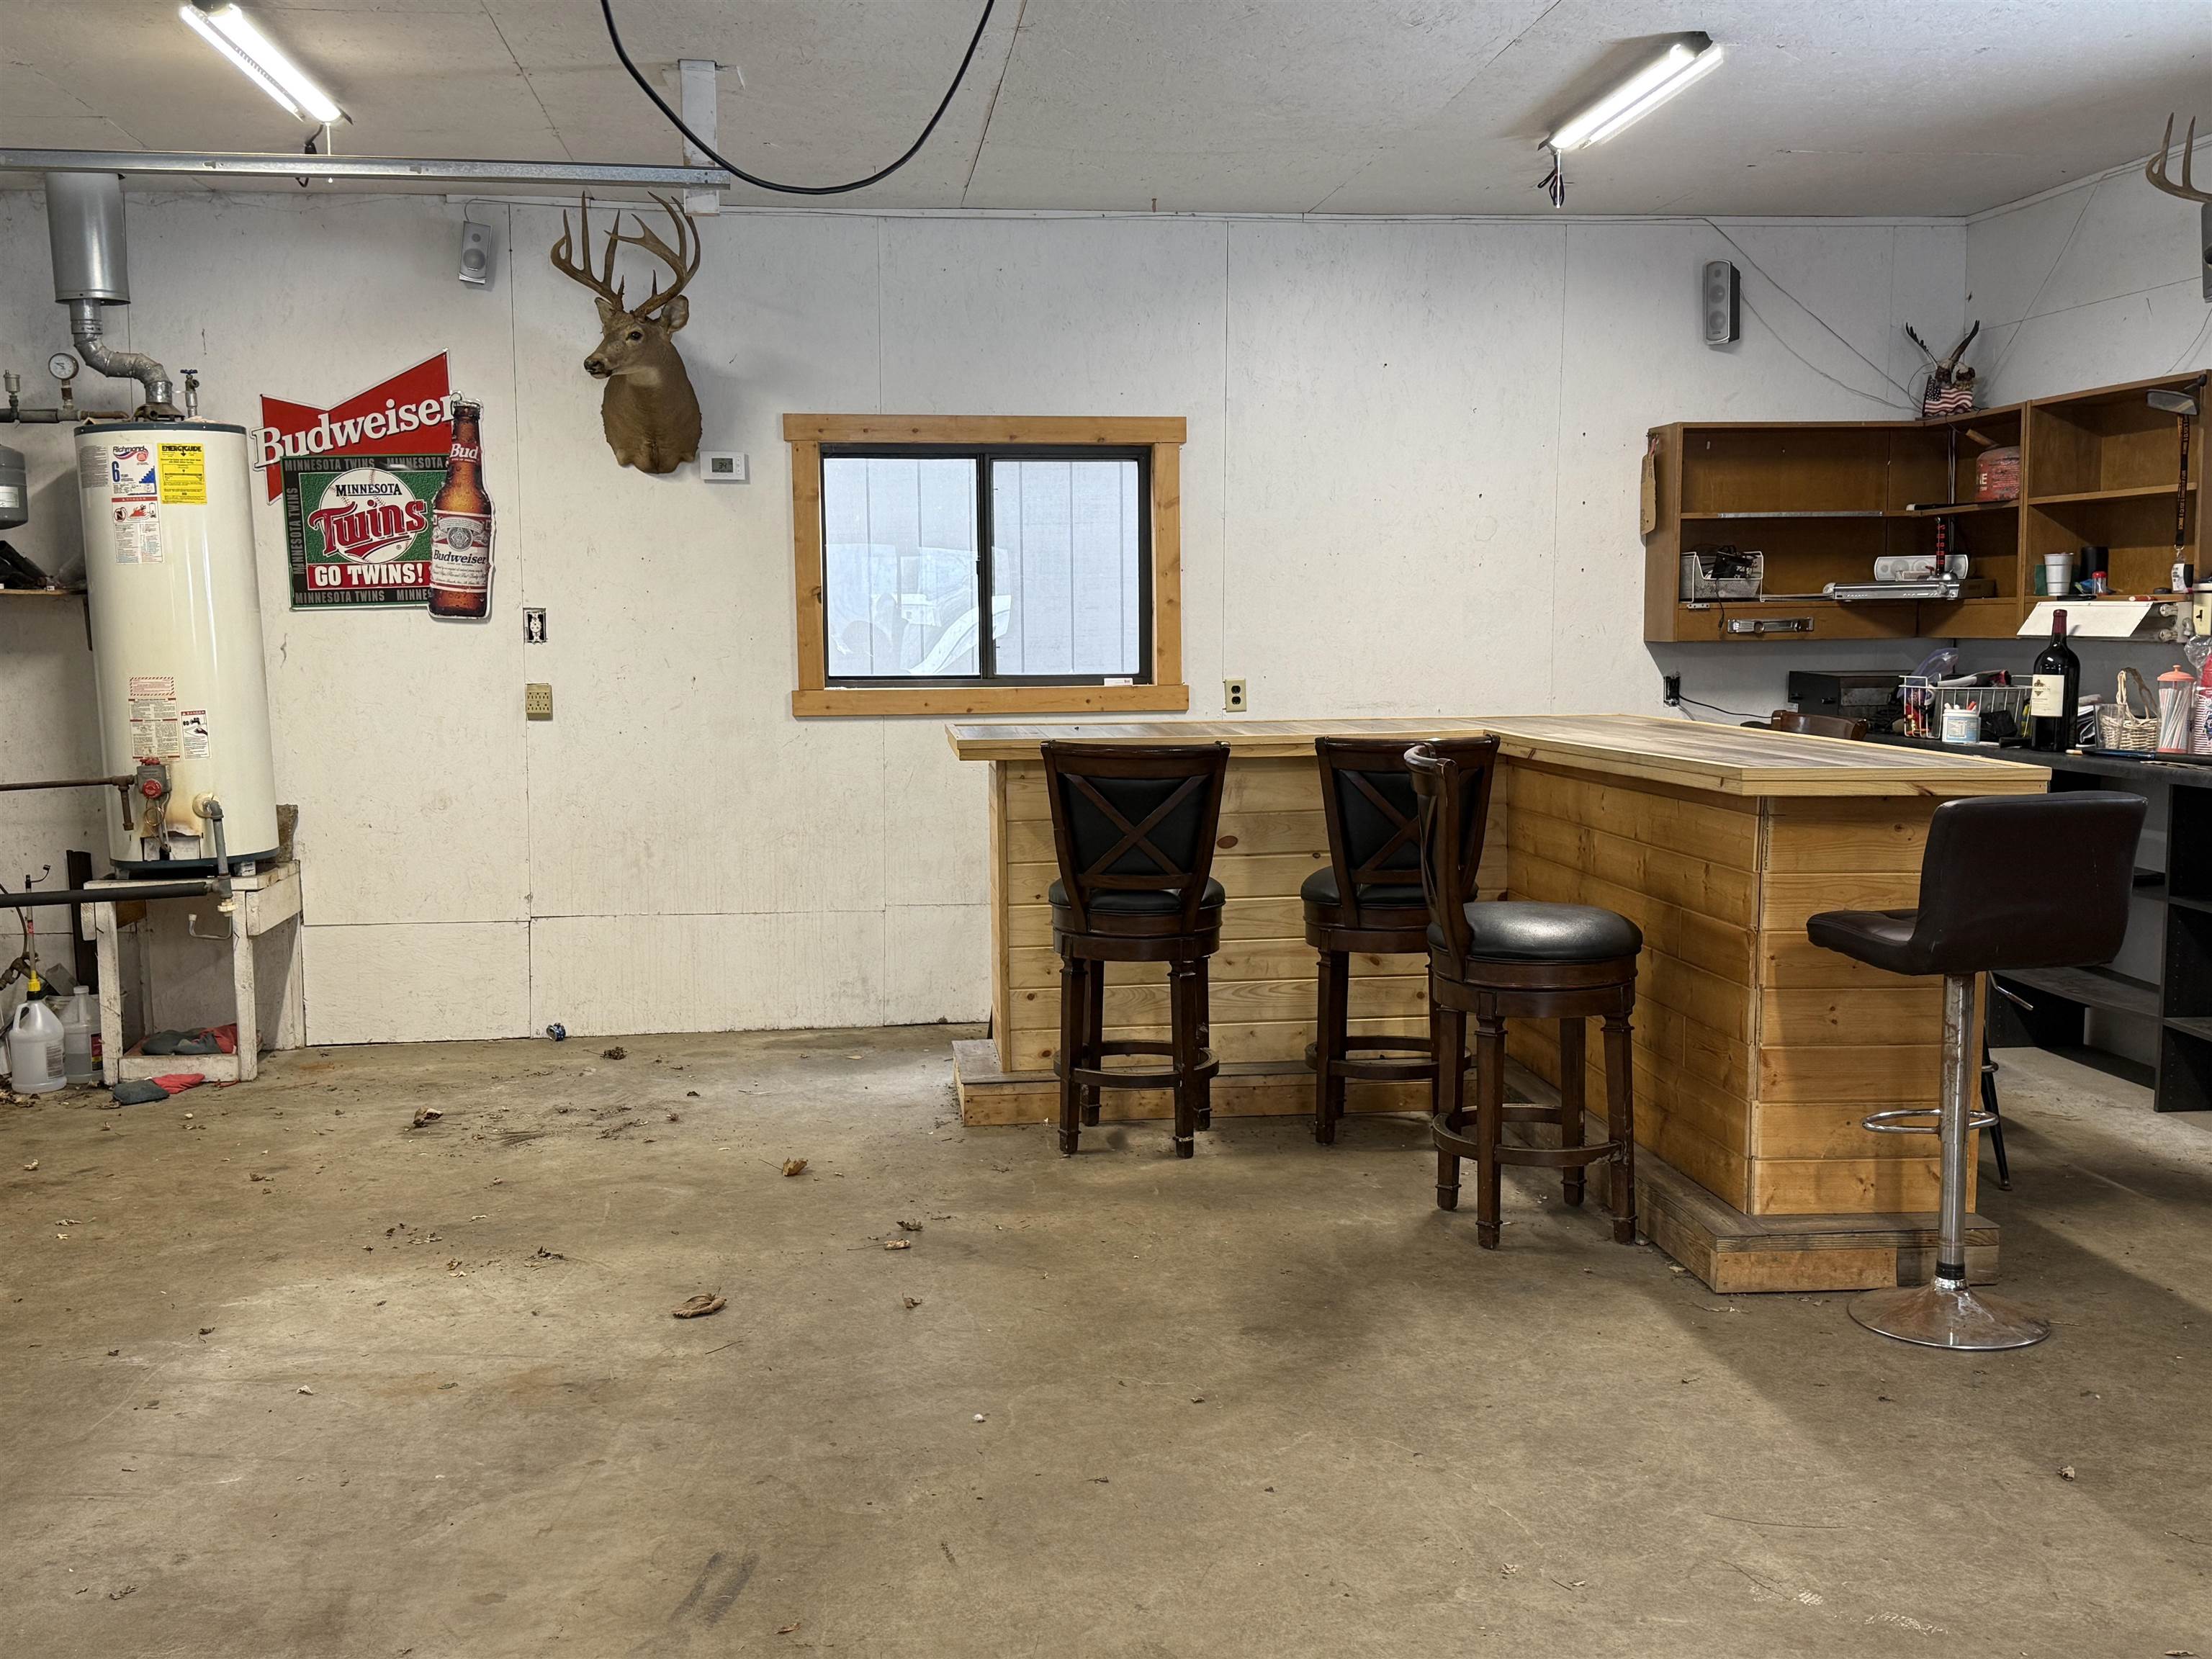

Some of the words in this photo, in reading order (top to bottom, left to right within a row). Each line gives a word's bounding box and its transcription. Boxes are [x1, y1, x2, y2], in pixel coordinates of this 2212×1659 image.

[252, 395, 461, 467] Budweiser
[449, 443, 478, 459] Bud
[112, 461, 120, 482] 6
[284, 459, 341, 472] MINNESOTA
[344, 458, 374, 469] TWINS
[387, 457, 444, 469] MINNESOTA
[336, 484, 403, 497] MINNESOTA
[287, 487, 300, 517] TWINS
[308, 499, 427, 555] Twins
[289, 520, 305, 575] MINNESOTA
[433, 549, 487, 565] Budweiser
[315, 565, 341, 587] GO
[347, 562, 423, 585] TWINS!
[295, 591, 352, 603] MINNESOTA
[355, 590, 385, 602] TWINS
